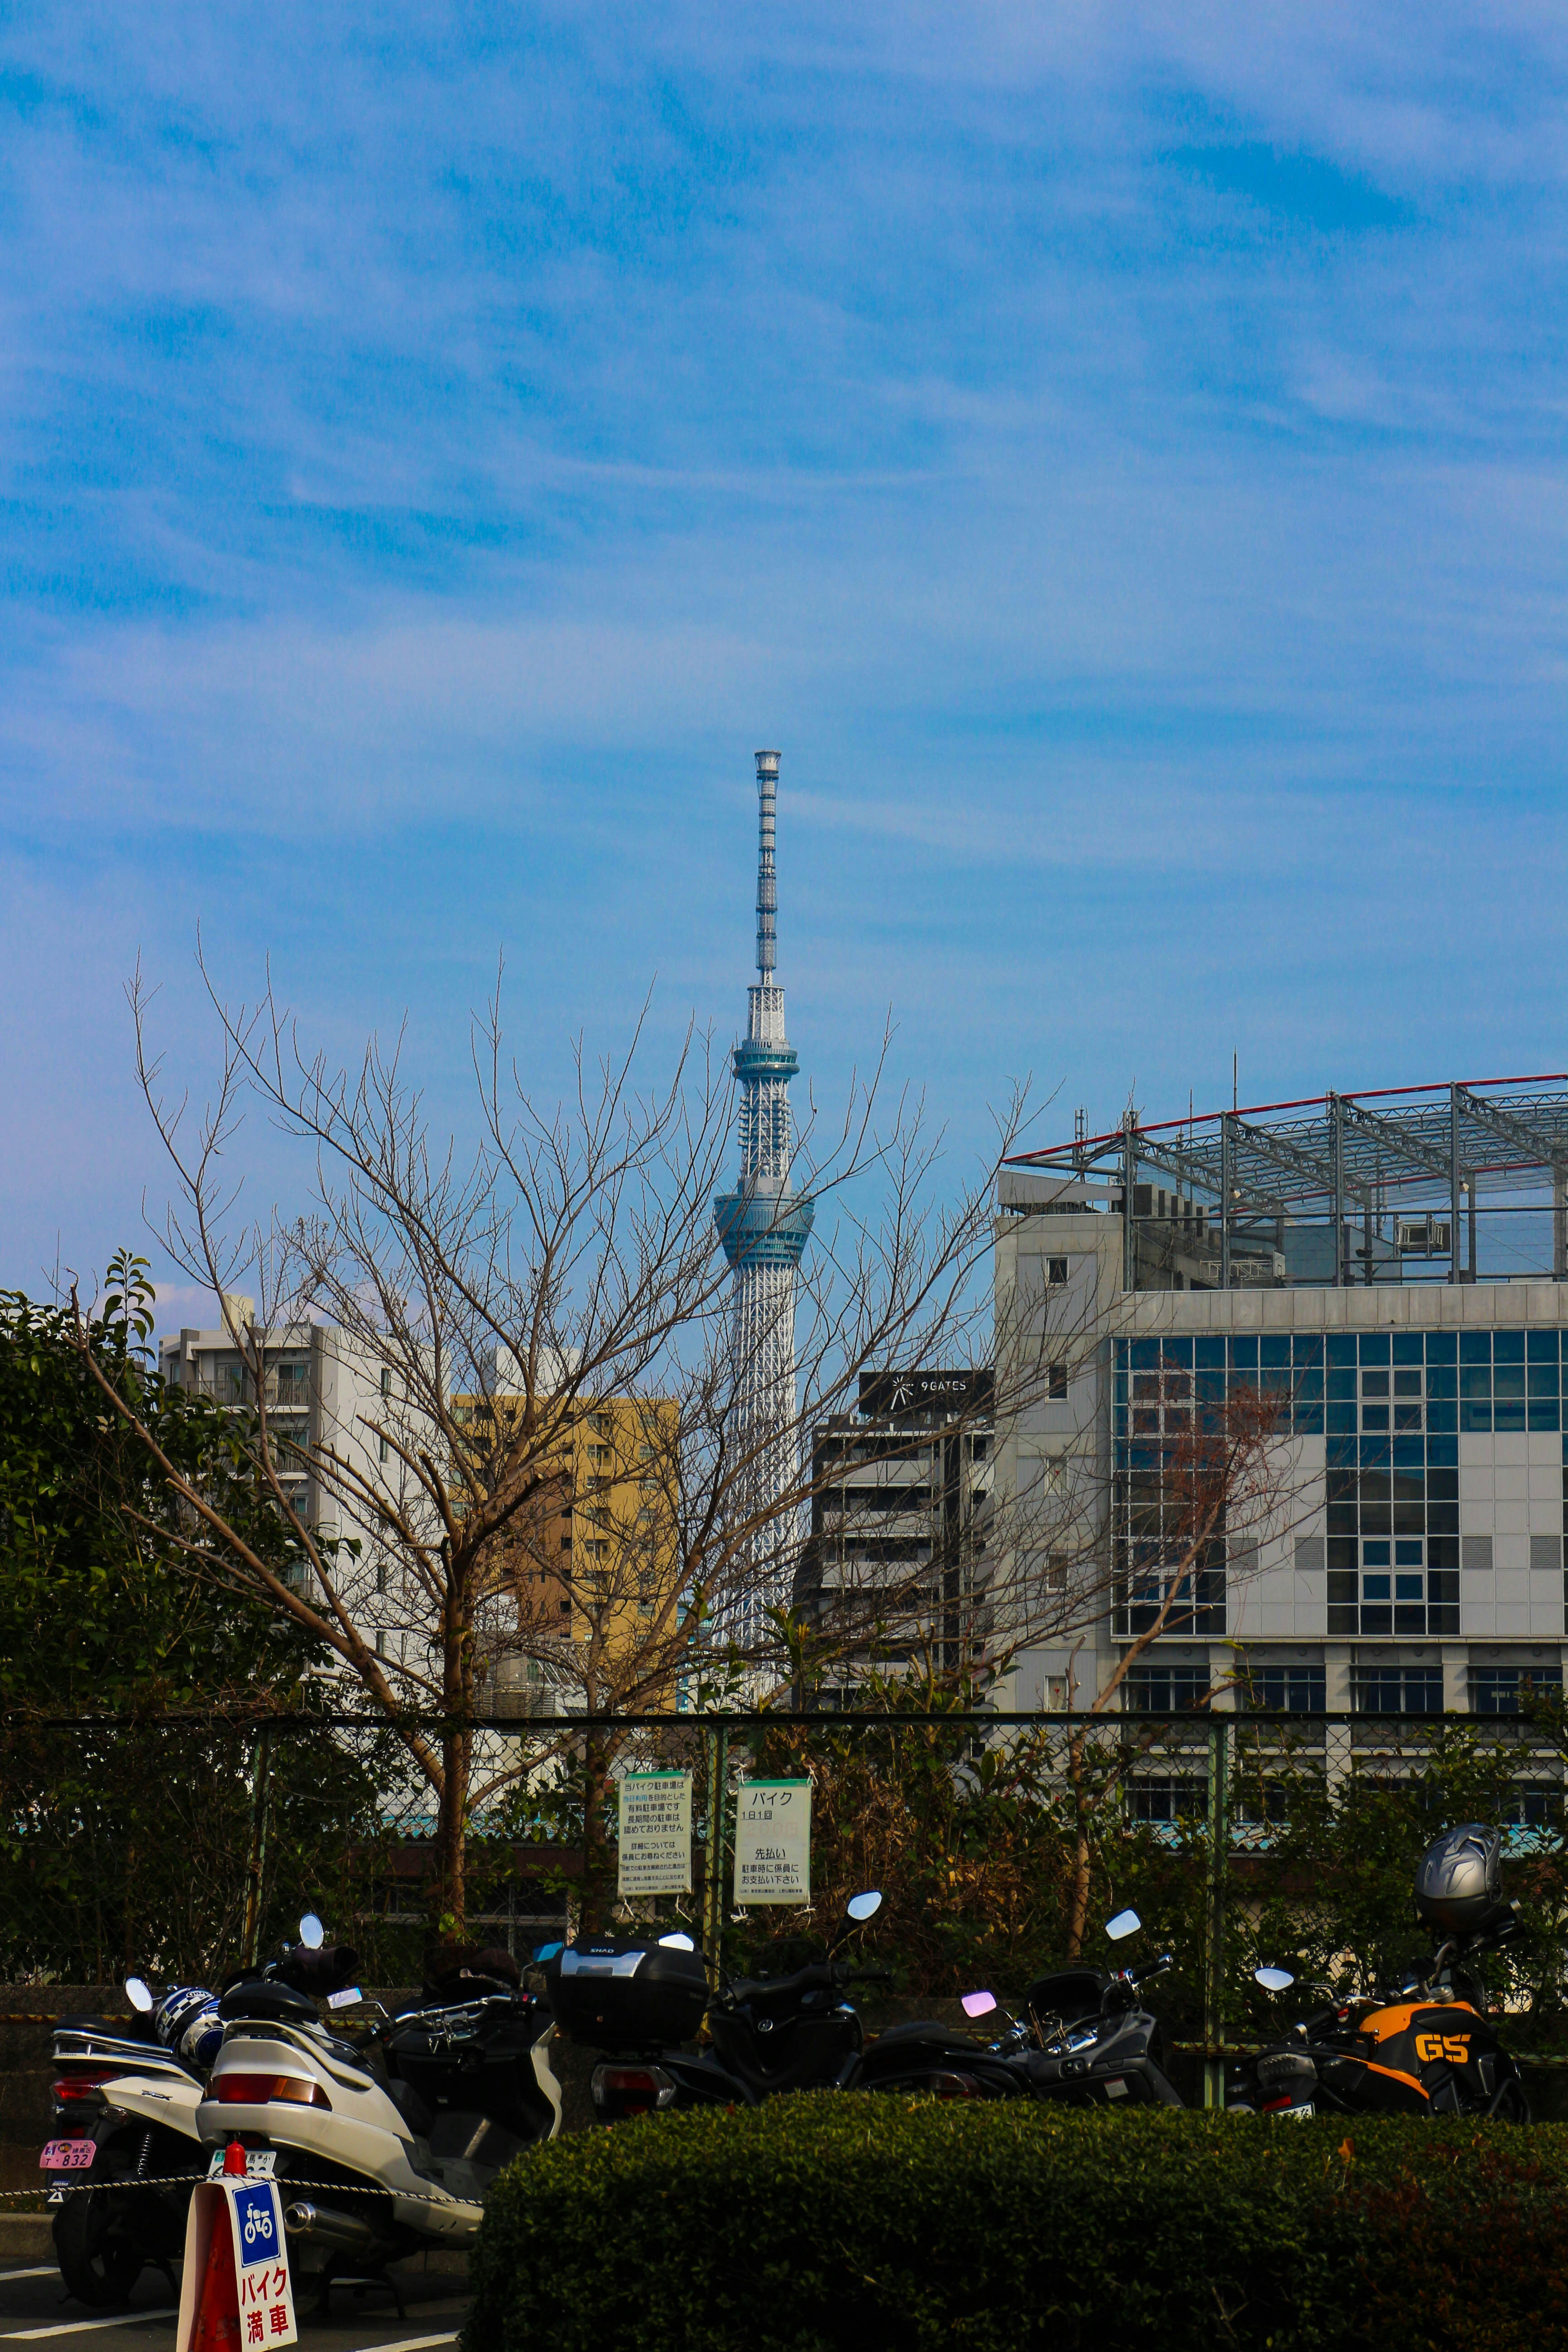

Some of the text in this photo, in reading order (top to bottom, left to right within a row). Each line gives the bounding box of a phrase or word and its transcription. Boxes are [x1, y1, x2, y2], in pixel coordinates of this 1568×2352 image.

[625, 1781, 684, 1792] 当バイク駐車場は
[623, 1793, 686, 1803] 当日利用を目的とした
[752, 1792, 792, 1806] バイク
[628, 1803, 680, 1813] 有料駐車場です
[628, 1814, 680, 1824] 長期間の駐車は
[741, 1811, 772, 1819] 1日1回
[624, 1823, 684, 1834] 認めておりません
[631, 1842, 676, 1850] 詳細については
[622, 1852, 685, 1861] 係員にお尋ねください
[755, 1848, 786, 1859] 先払い
[742, 1864, 799, 1873] 駐車時に係員に
[742, 1875, 799, 1884] お支払い下さい
[1416, 2034, 1471, 2063] GS
[62, 2154, 88, 2166] 832
[242, 2267, 286, 2307] バイク
[247, 2304, 289, 2344] 満車
